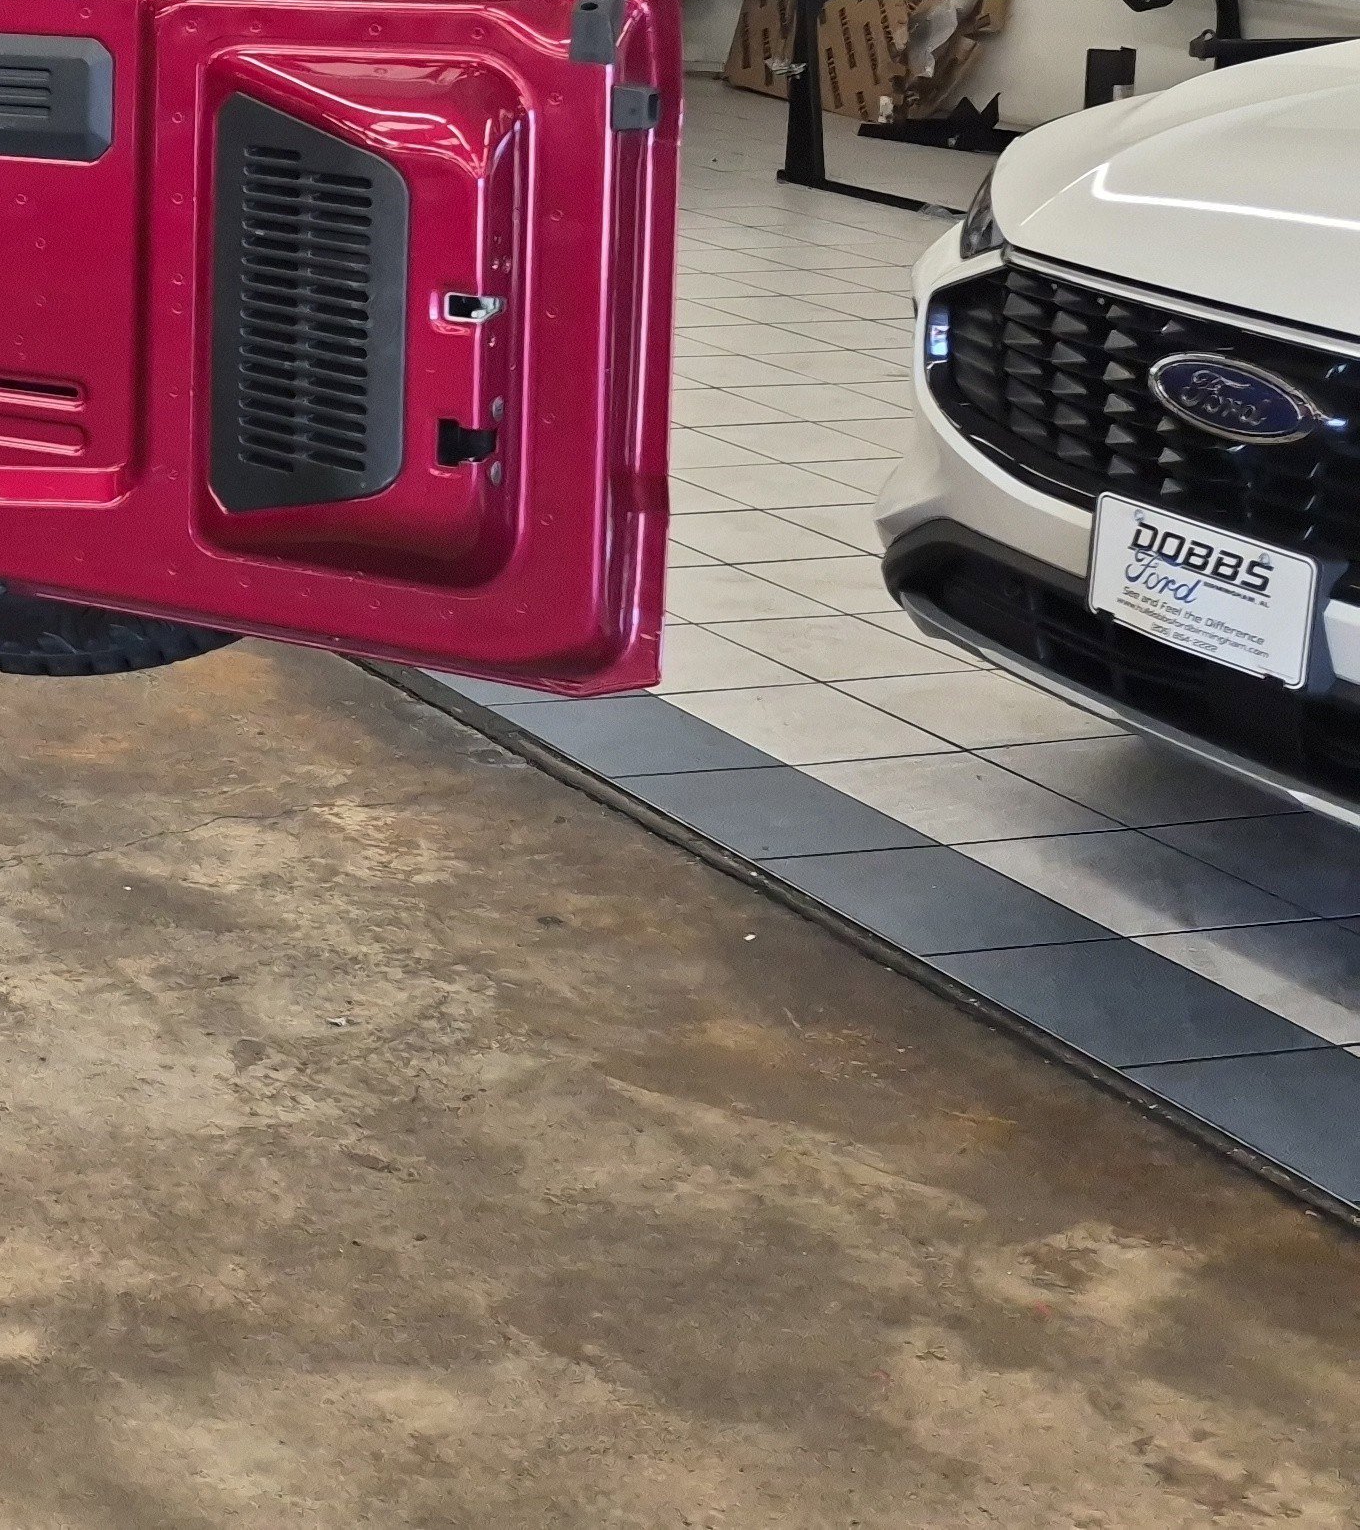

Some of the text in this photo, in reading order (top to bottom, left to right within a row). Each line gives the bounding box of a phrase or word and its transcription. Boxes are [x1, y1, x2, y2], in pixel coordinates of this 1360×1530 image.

[1180, 369, 1271, 426] Ford
[1125, 548, 1202, 603] Ford
[1130, 521, 1275, 592] DOBBS
[1122, 586, 1265, 645] See and Feel the Difference
